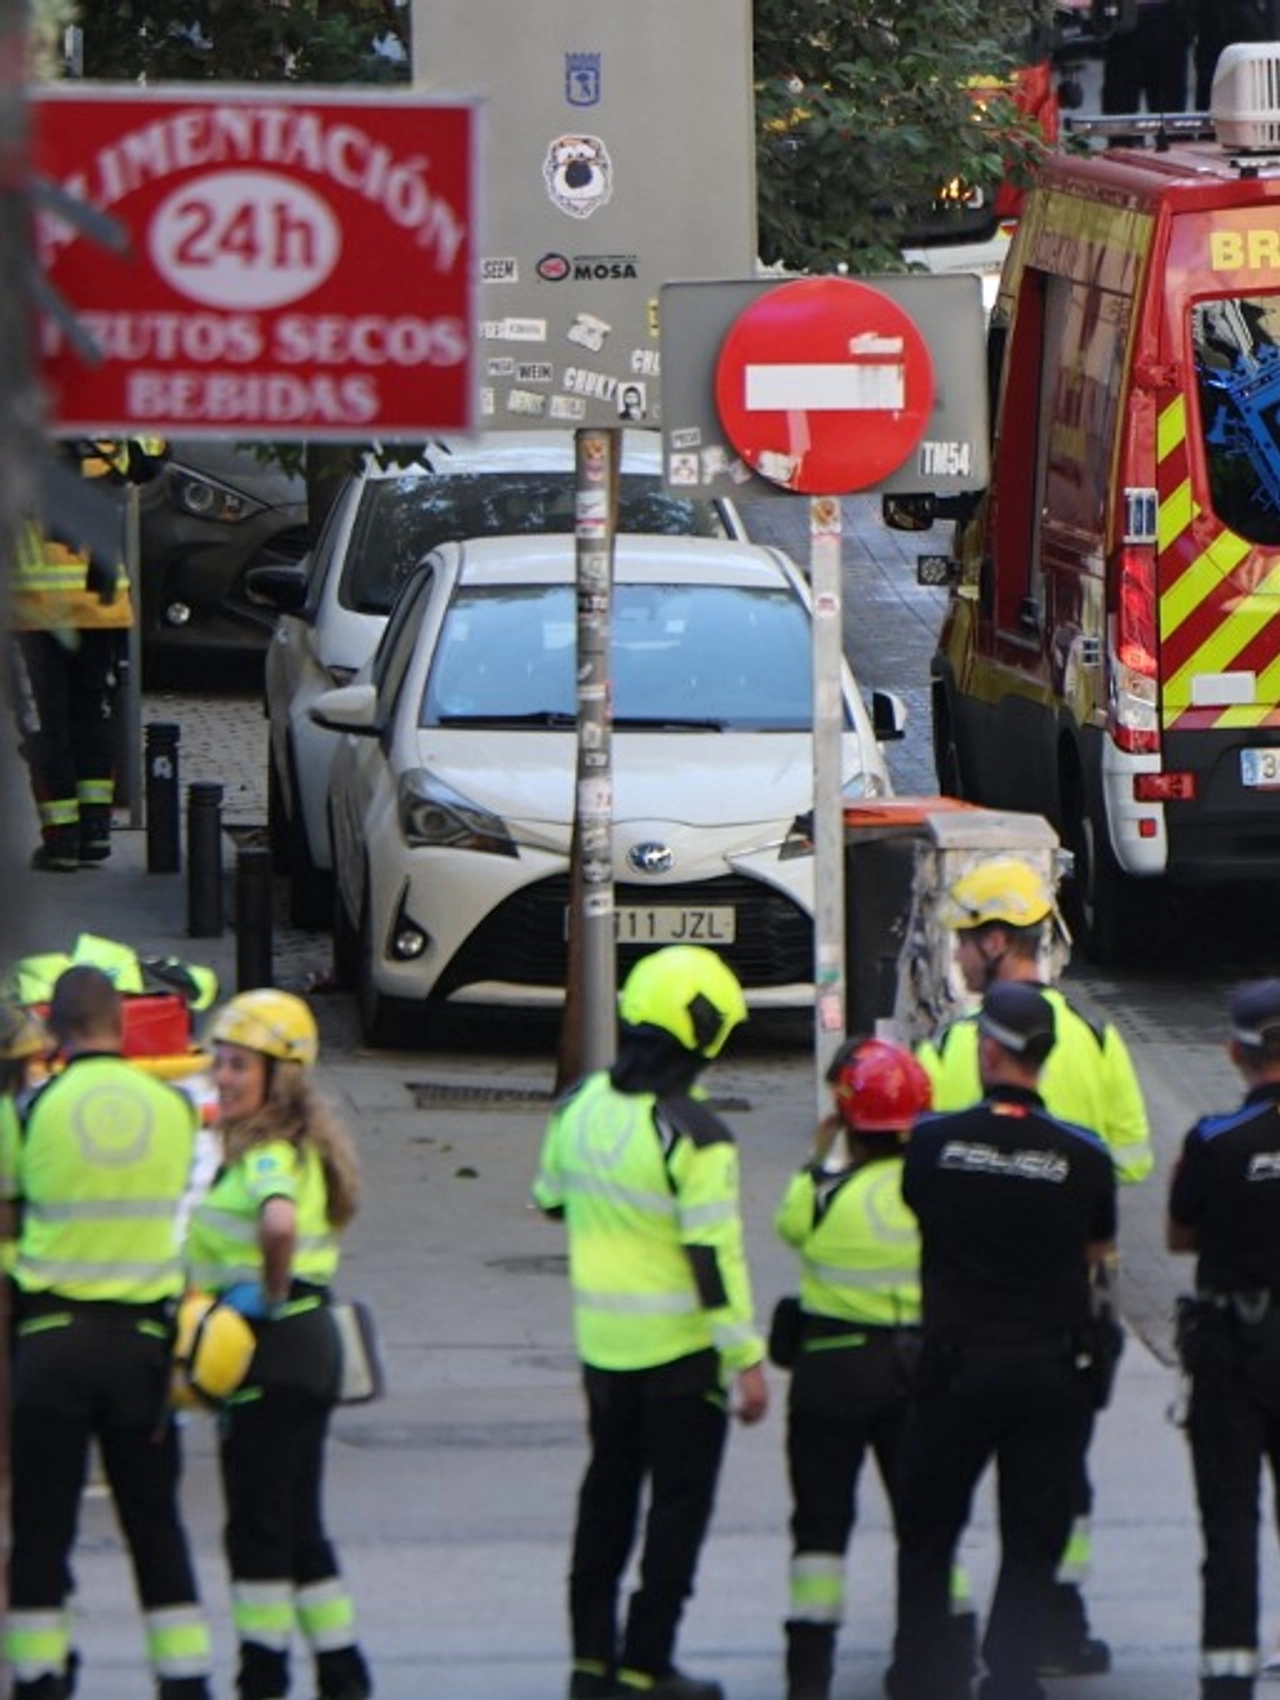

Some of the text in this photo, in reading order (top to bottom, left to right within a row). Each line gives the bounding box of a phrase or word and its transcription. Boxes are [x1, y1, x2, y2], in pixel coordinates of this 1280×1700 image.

[173, 200, 316, 269] 24h
[574, 264, 638, 281] MOSA
[275, 314, 467, 367] SECOS
[126, 369, 381, 422] BEBIDAS
[671, 912, 724, 938] JZL
